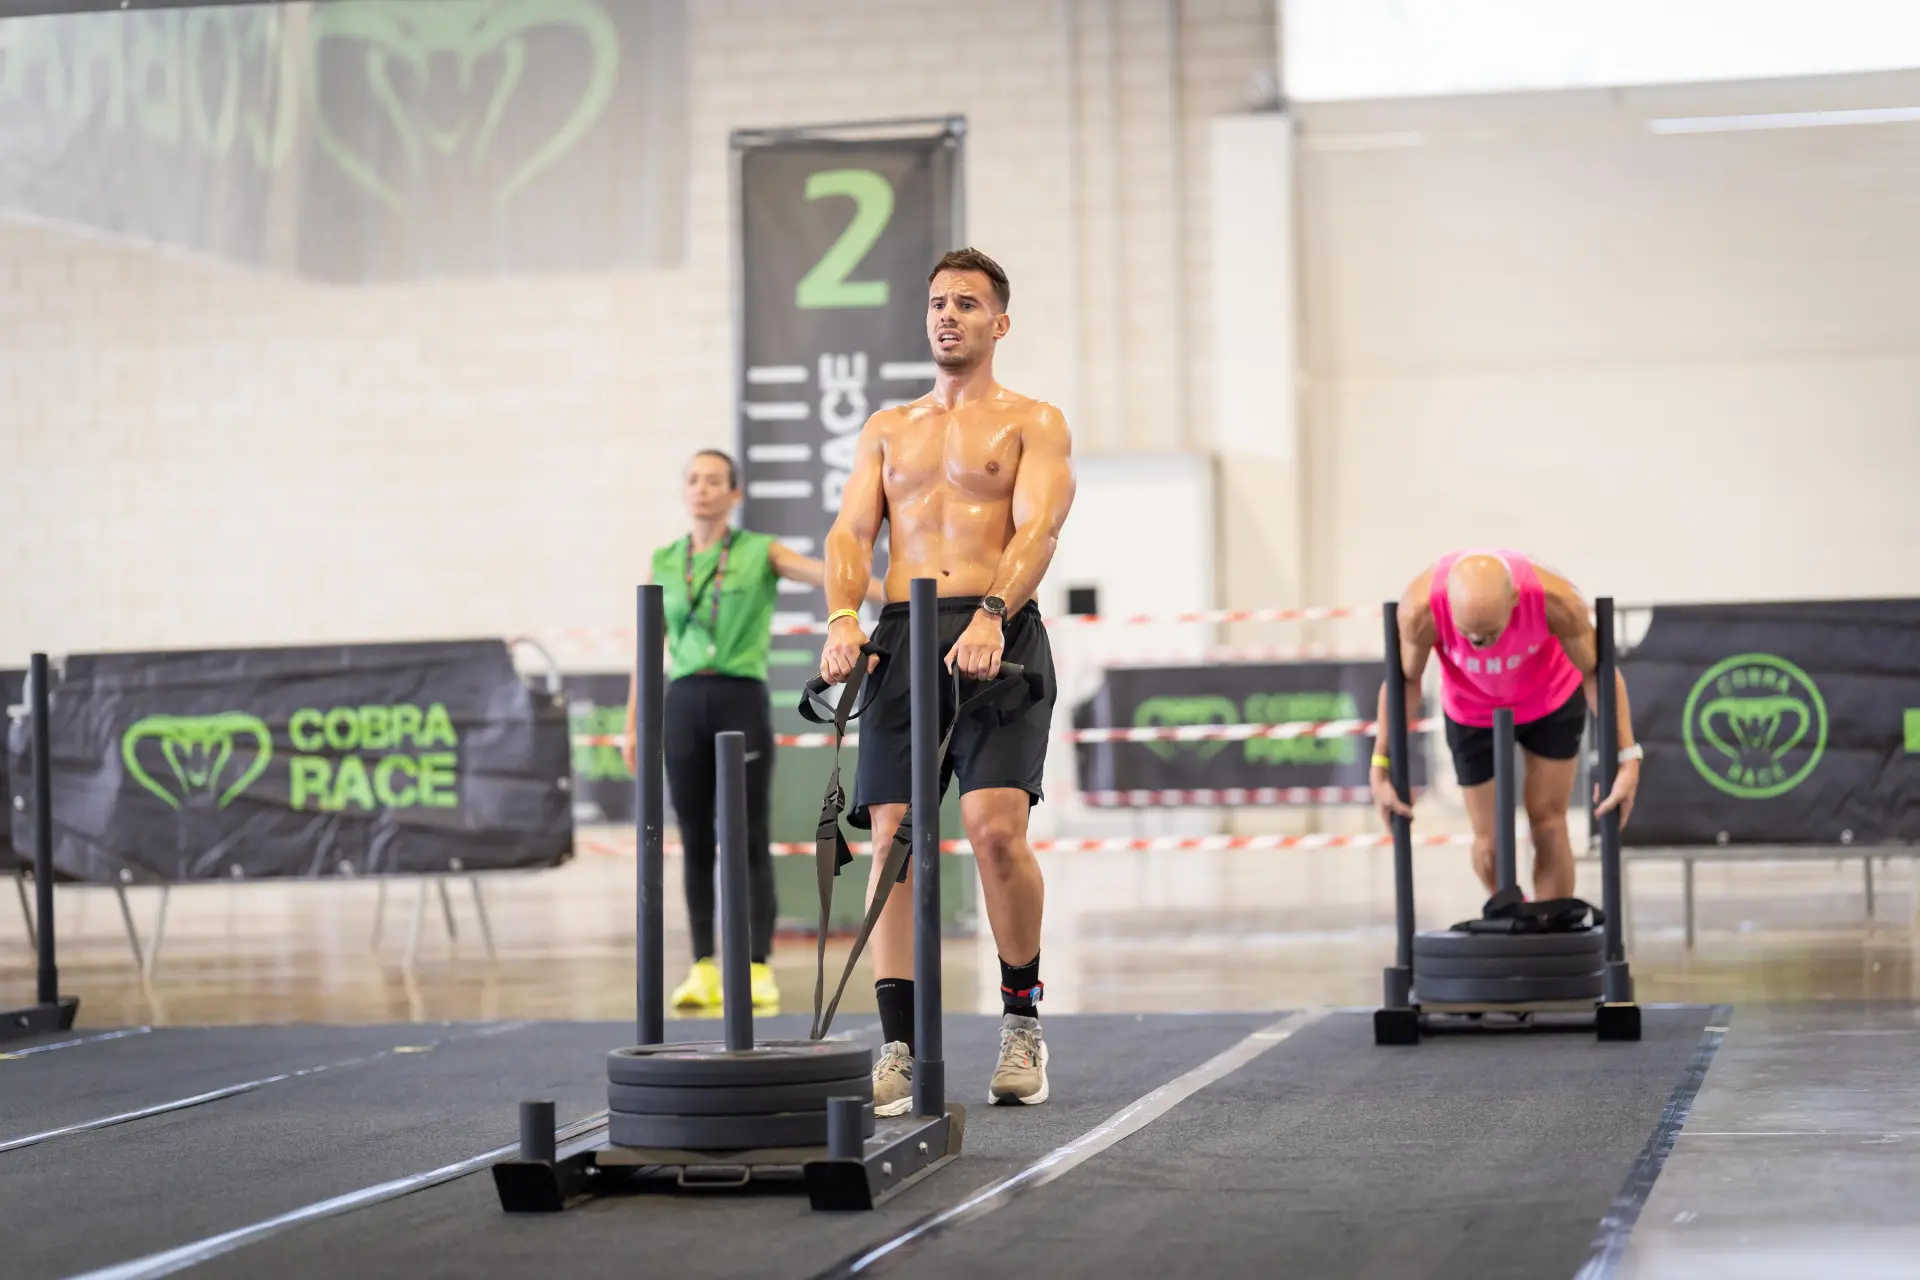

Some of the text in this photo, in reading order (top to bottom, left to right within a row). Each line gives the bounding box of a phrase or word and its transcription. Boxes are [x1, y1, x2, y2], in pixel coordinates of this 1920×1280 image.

[795, 169, 895, 308] 2
[289, 702, 457, 751] COBRA
[290, 752, 458, 811] RACE
